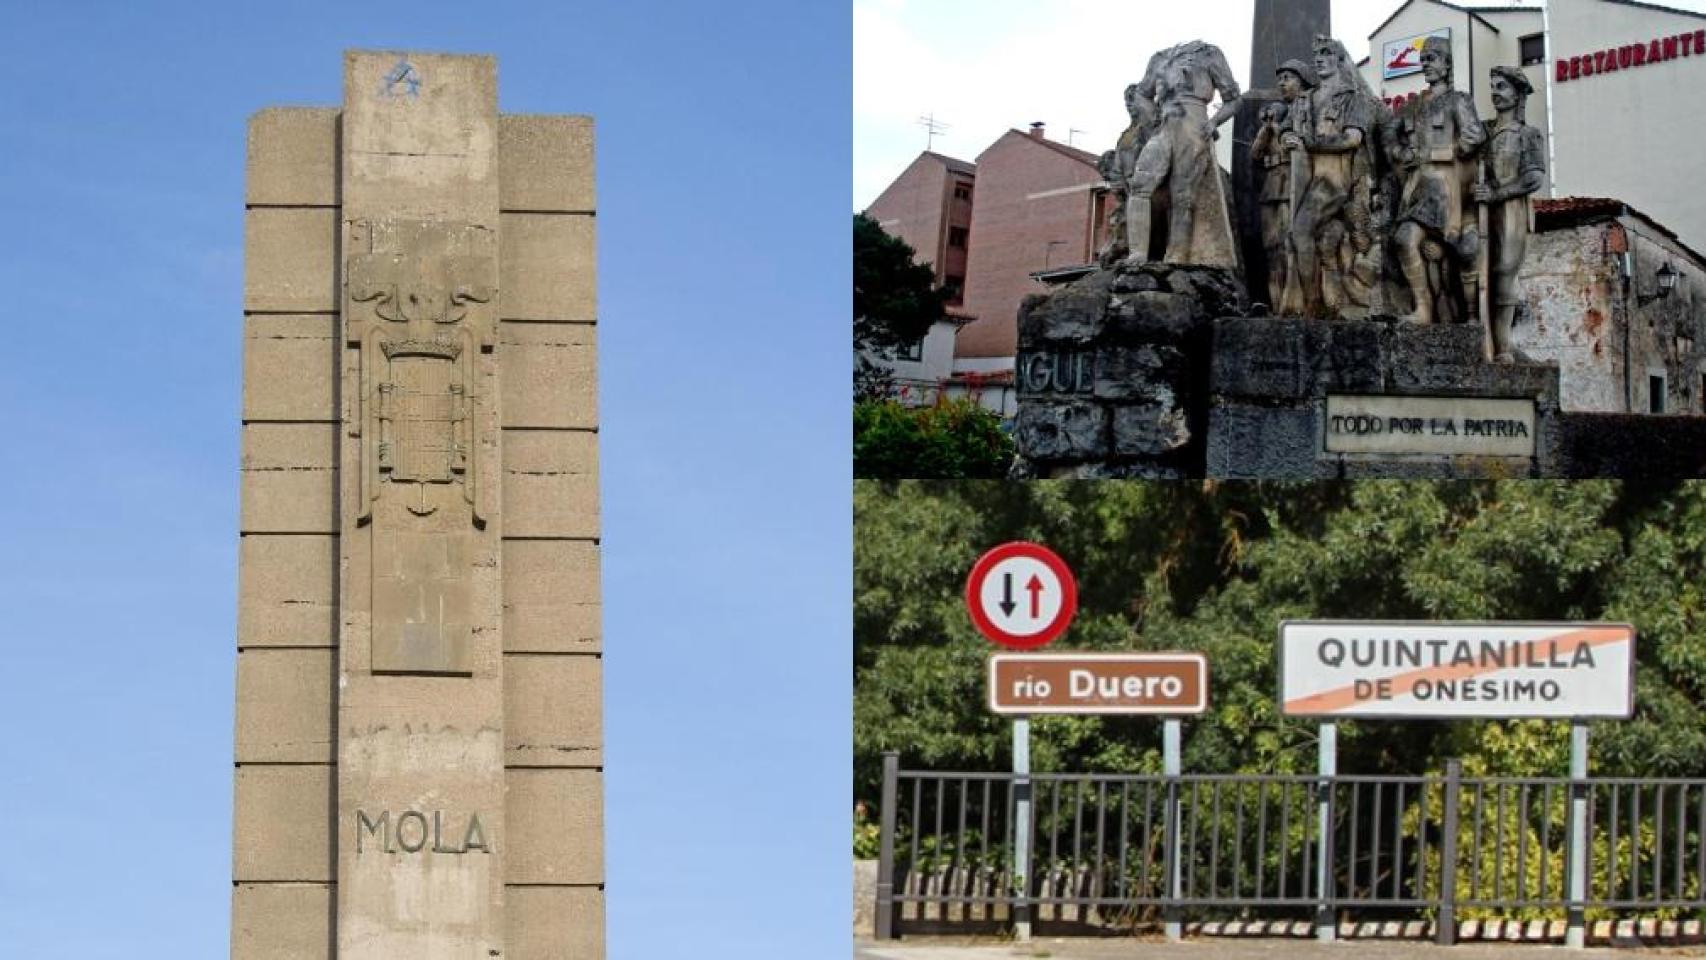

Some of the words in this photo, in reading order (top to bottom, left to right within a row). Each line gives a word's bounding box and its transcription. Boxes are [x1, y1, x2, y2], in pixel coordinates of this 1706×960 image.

[1556, 29, 1705, 82] RESTAURANTE
[1332, 415, 1383, 434] TODO
[1389, 418, 1424, 435] POR
[1431, 418, 1458, 436] LA
[1464, 418, 1528, 438] PATRIA
[1318, 638, 1596, 668] QUINTANILLA
[1069, 670, 1183, 698] Duero
[1354, 679, 1392, 701] DE
[1412, 676, 1561, 702] ONÉSIMO
[357, 809, 492, 854] MOLA
